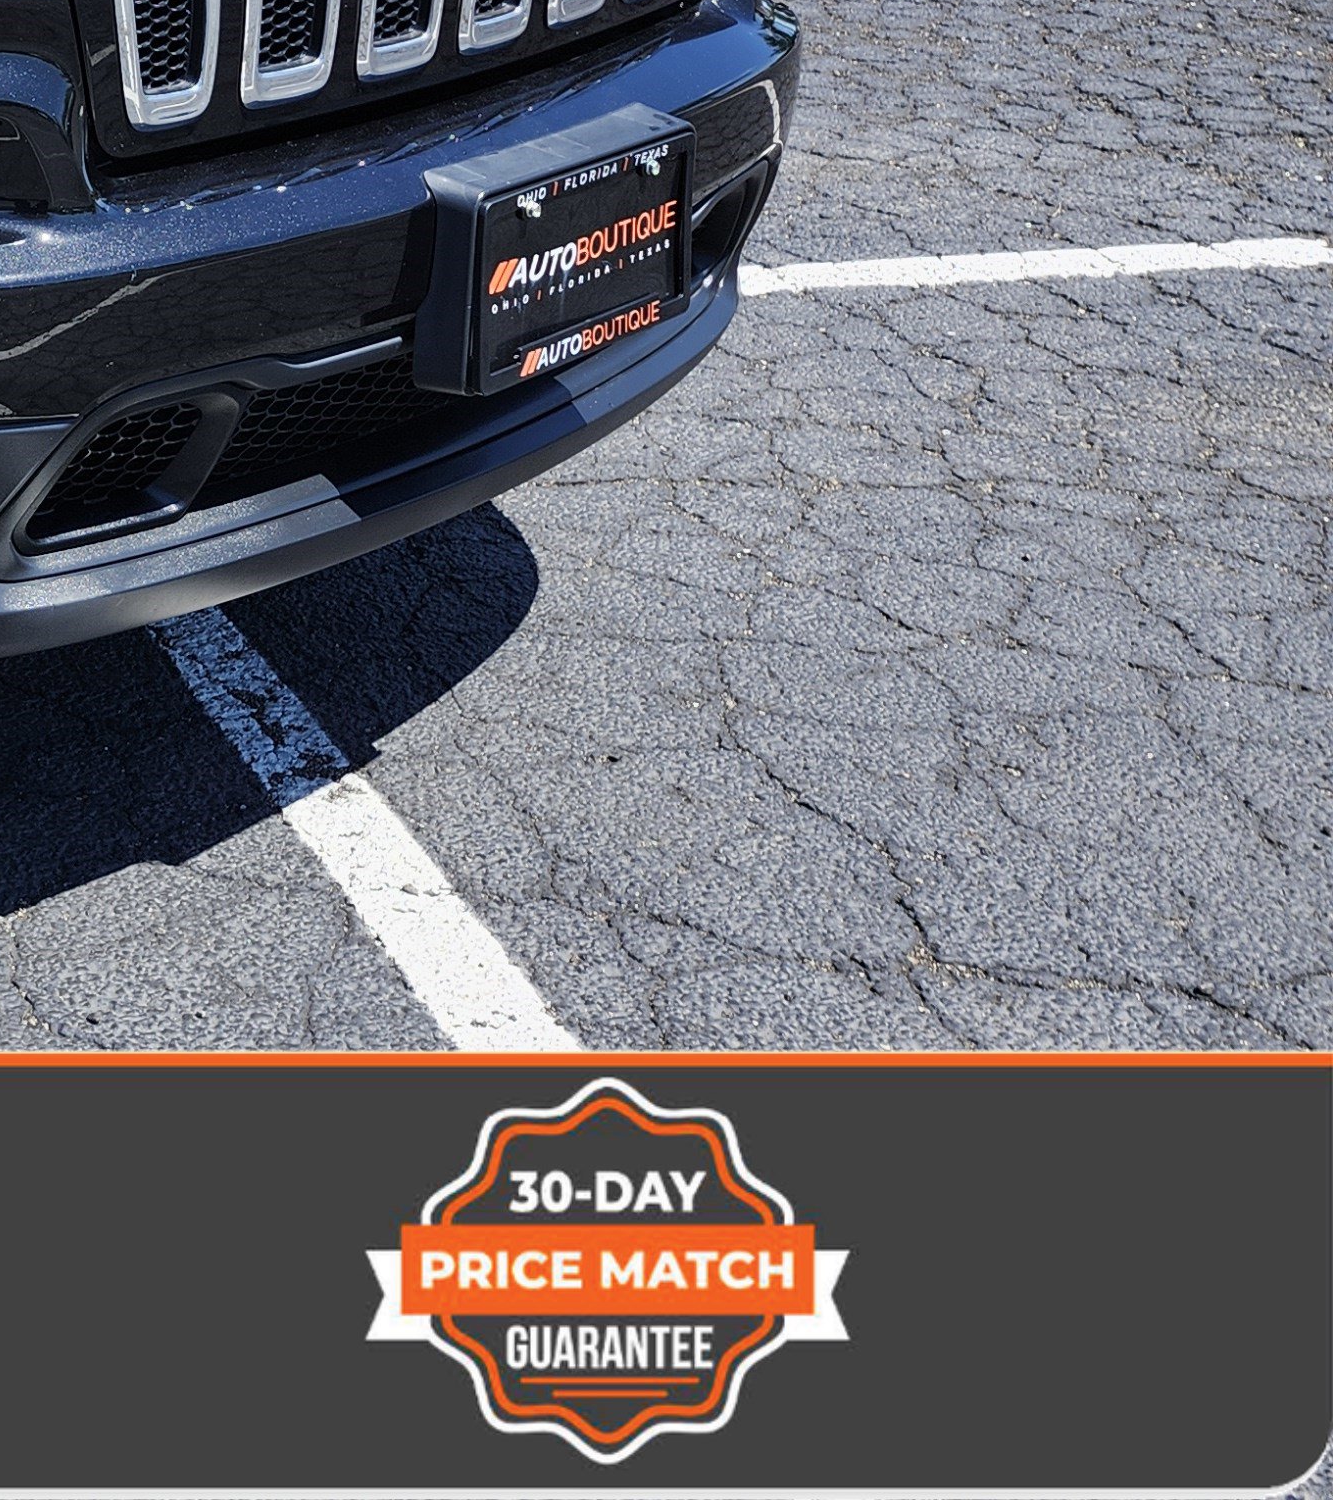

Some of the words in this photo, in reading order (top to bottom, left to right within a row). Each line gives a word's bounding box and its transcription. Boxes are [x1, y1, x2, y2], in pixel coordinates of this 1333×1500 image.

[516, 186, 547, 210] OHIO
[563, 162, 618, 191] FLORIDA
[633, 144, 670, 168] TEXAS
[491, 293, 530, 315] OHIO
[549, 264, 611, 297] FLORIDA
[629, 239, 671, 264] TEXAS
[507, 200, 678, 288] AUTOBOUTIQUE
[536, 299, 661, 371] AUTOBOUTIQUE
